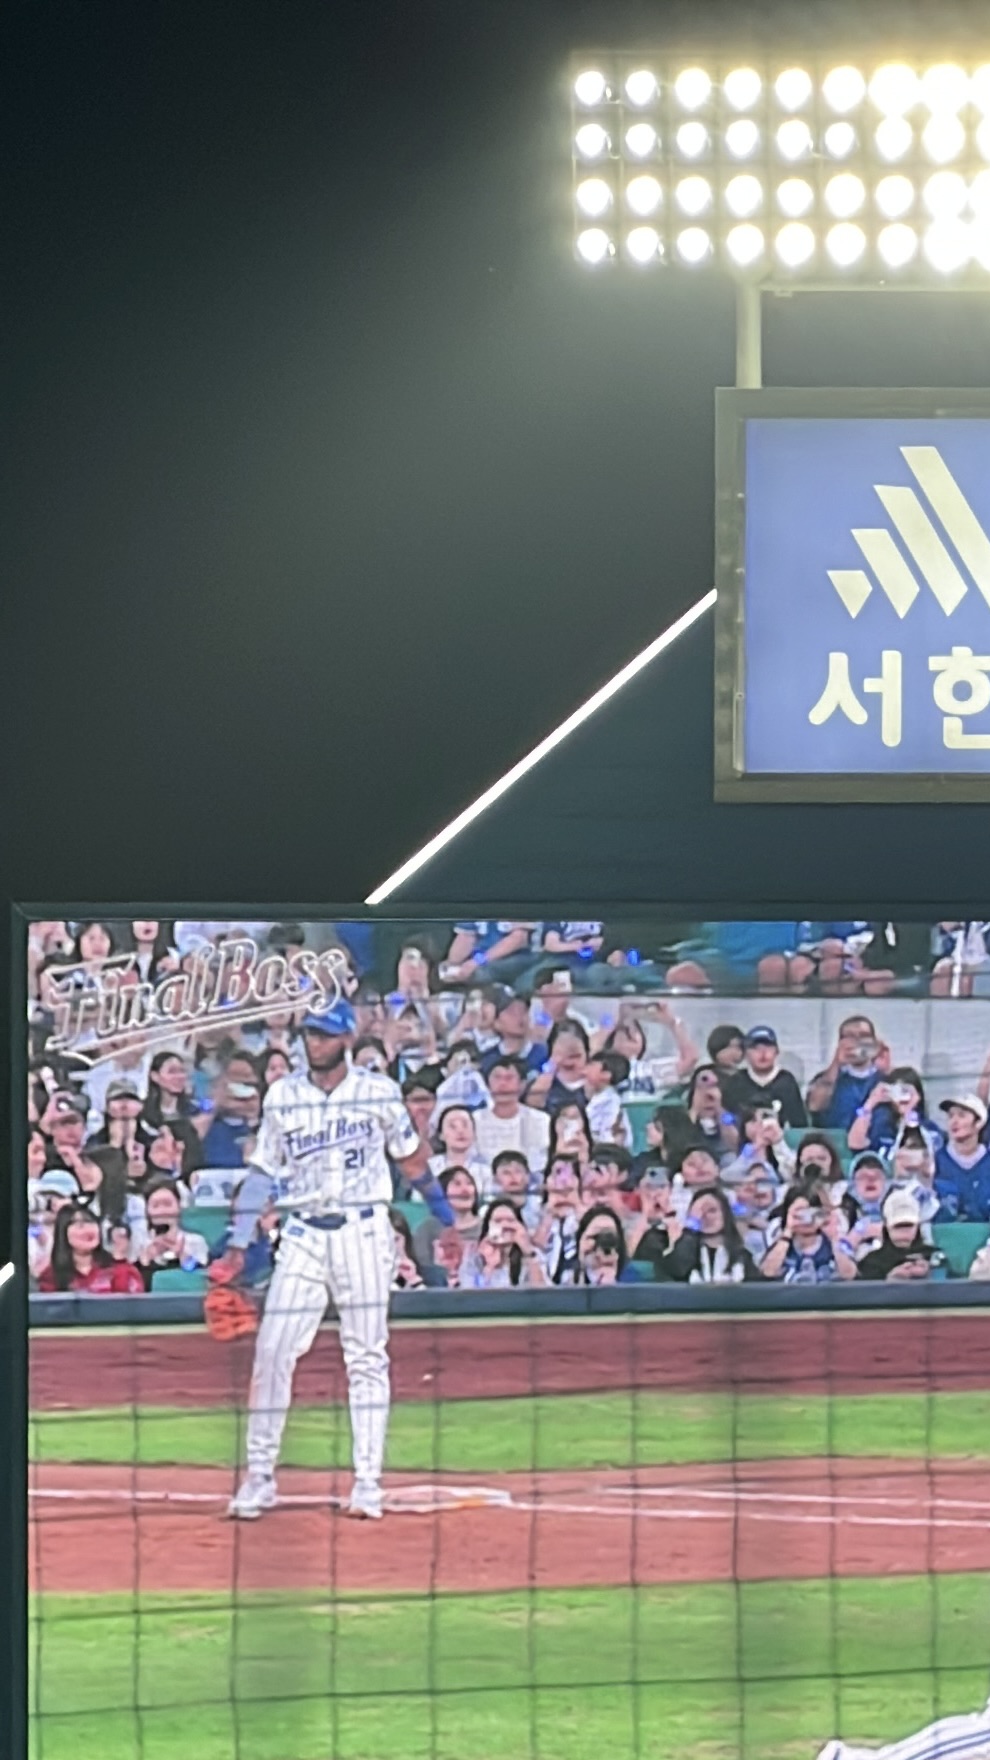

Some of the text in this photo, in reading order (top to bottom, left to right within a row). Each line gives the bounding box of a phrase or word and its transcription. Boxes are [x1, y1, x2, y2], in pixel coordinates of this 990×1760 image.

[45, 937, 347, 1051] Final Boss
[344, 1145, 365, 1169] 21
